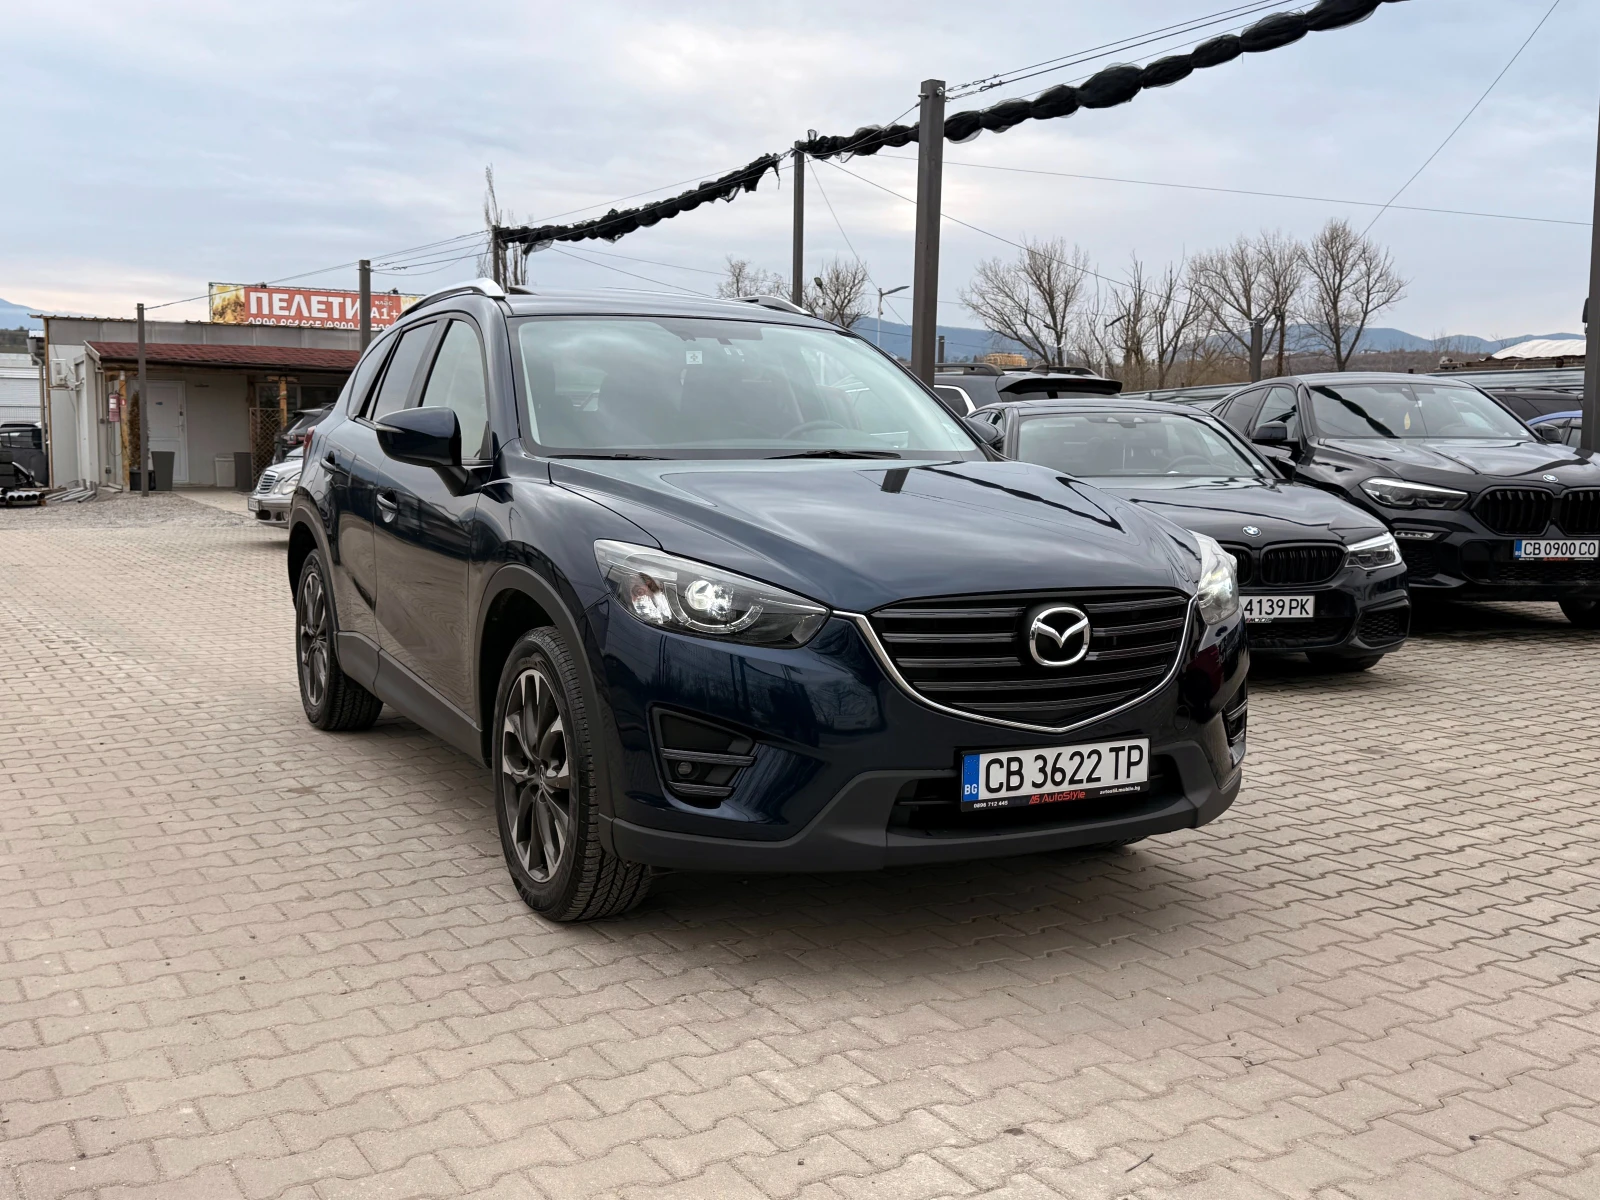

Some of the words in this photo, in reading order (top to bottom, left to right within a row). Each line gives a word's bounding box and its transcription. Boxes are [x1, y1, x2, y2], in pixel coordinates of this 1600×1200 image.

[249, 291, 360, 320] ПЕЛЕТИ
[1524, 542, 1541, 556] CB
[1544, 542, 1576, 556] 0900
[1578, 542, 1596, 556] CO
[1244, 598, 1286, 615] 4139
[1288, 598, 1310, 615] PK
[985, 756, 1025, 794] CB
[1031, 748, 1102, 789] 3622
[1109, 744, 1144, 780] TP
[964, 784, 978, 795] BG
[1041, 790, 1086, 803] AutoStyle
